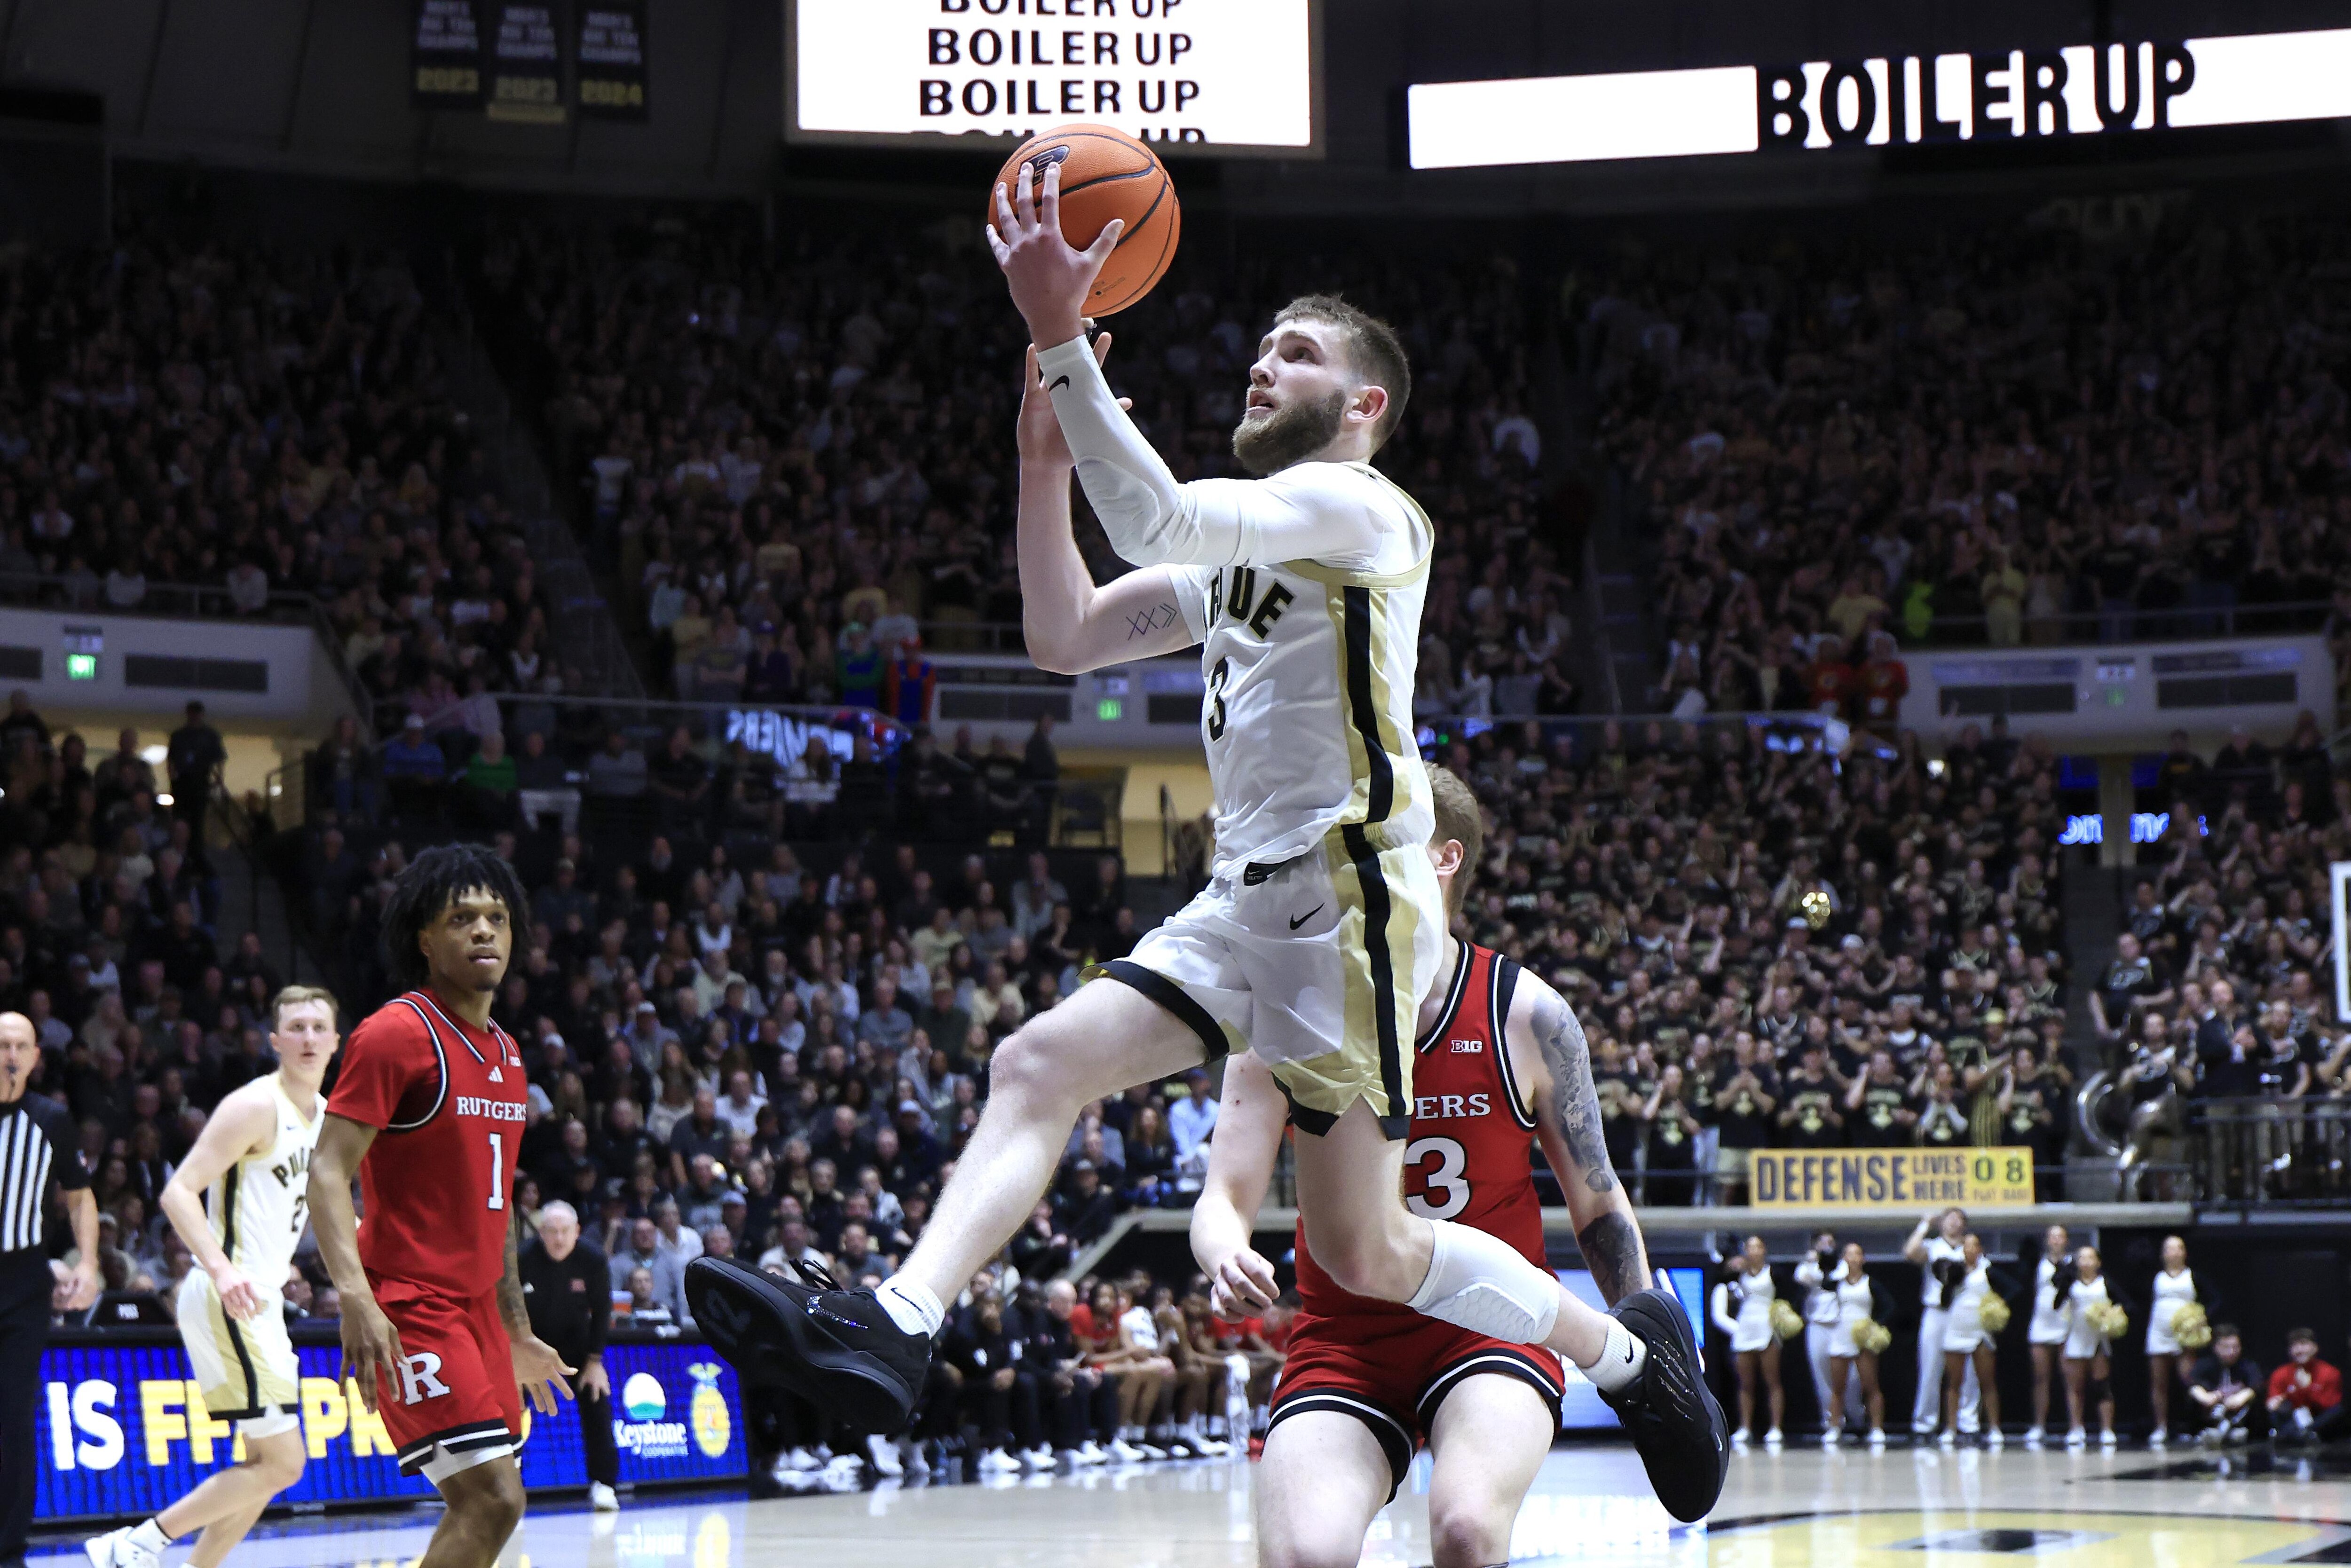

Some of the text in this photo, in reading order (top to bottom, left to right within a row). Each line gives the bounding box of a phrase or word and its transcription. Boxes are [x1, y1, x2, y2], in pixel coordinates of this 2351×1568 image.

[929, 28, 1191, 65] BOILER UP
[920, 79, 1199, 117] BOILER UP
[1208, 655, 1228, 742] 3
[1414, 1093, 1491, 1120] ERS
[487, 1132, 505, 1210] 1
[1404, 1136, 1471, 1221] 3
[1758, 1156, 1906, 1201] DEFENSE
[1914, 1155, 1966, 1174] LIVES
[1914, 1180, 1965, 1200] HERE
[396, 1352, 450, 1406] R
[47, 1379, 125, 1471] IS
[140, 1379, 247, 1467] FF
[613, 1419, 688, 1455] Keystone
